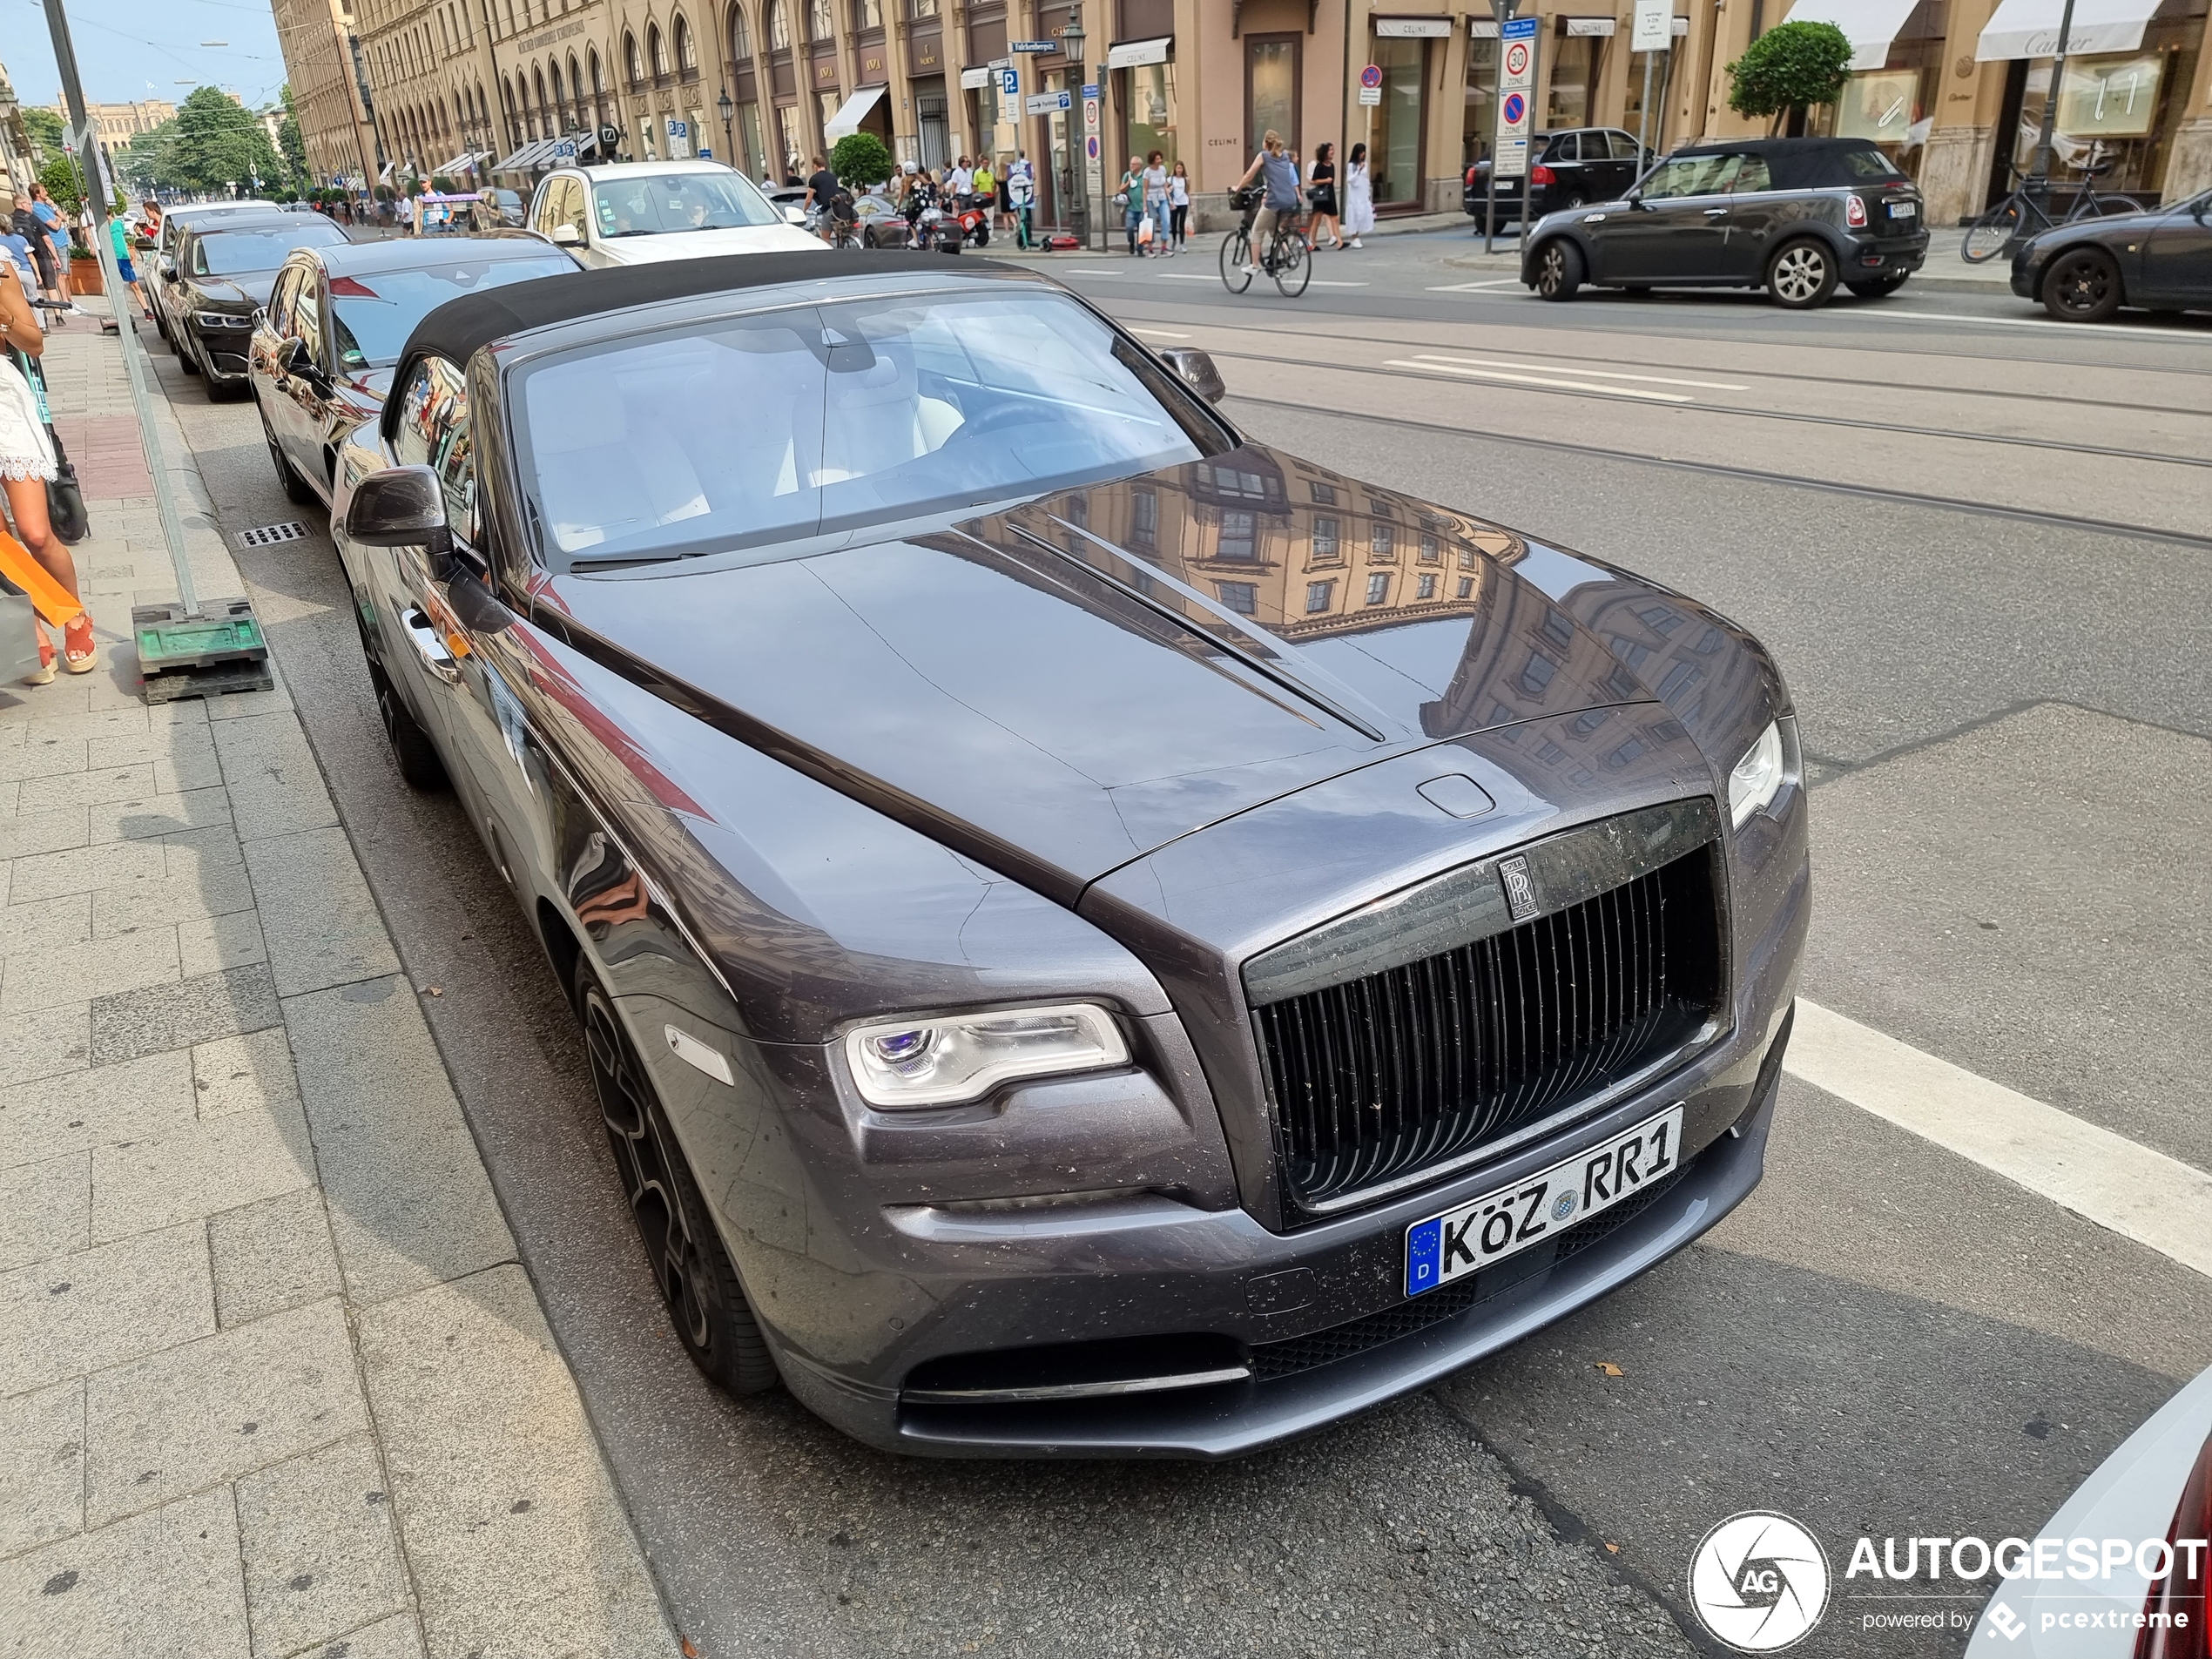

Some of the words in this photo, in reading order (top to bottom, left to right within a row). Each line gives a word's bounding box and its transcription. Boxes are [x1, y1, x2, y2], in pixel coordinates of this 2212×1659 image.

[2024, 31, 2093, 54] Carier
[1511, 51, 1524, 67] 30
[1507, 76, 1525, 86] ZONE
[1501, 860, 1525, 873] ROLLS
[1507, 873, 1533, 904] RR
[1514, 902, 1536, 916] ROYCE
[1418, 1264, 1430, 1280] D
[1443, 1180, 1549, 1274] KÖZ
